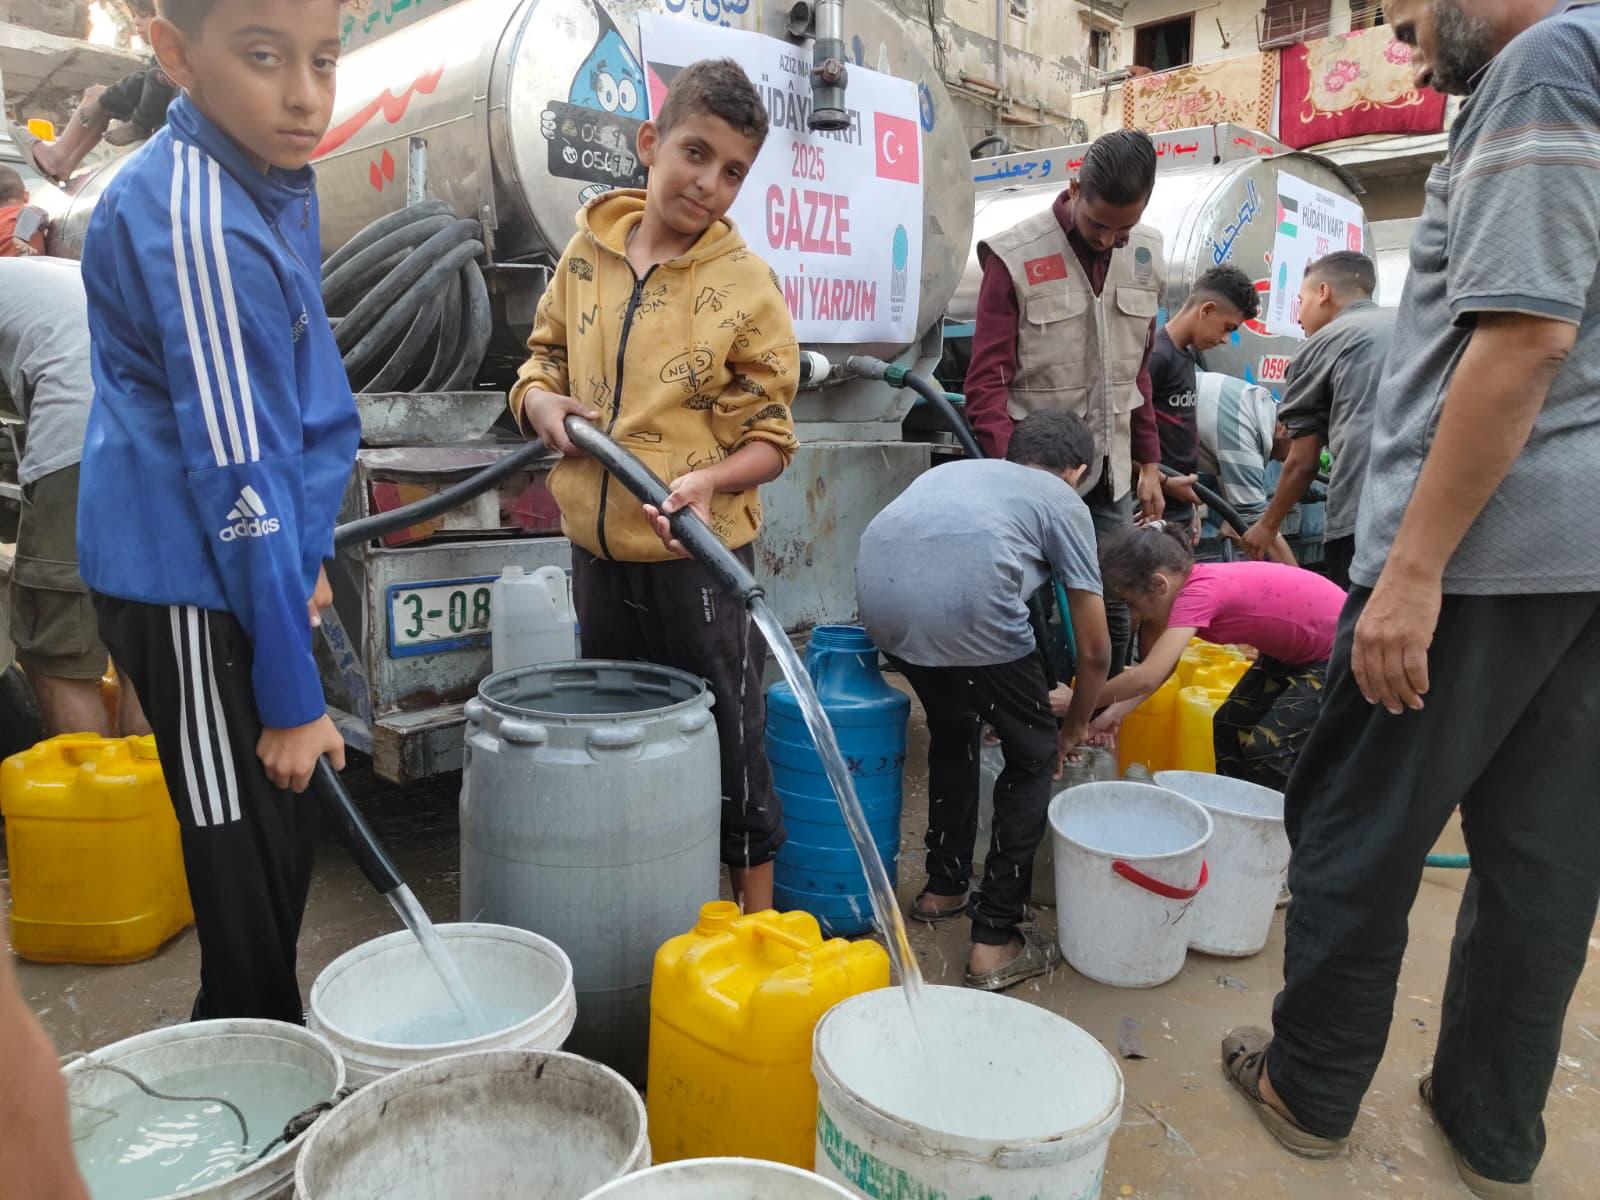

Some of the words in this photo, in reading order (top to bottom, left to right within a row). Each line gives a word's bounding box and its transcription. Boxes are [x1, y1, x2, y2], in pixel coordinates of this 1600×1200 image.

[752, 73, 813, 135] ÜDÂYİ
[791, 141, 825, 182] 2025
[765, 183, 852, 257] GAZZE
[808, 276, 877, 322] YARDIM
